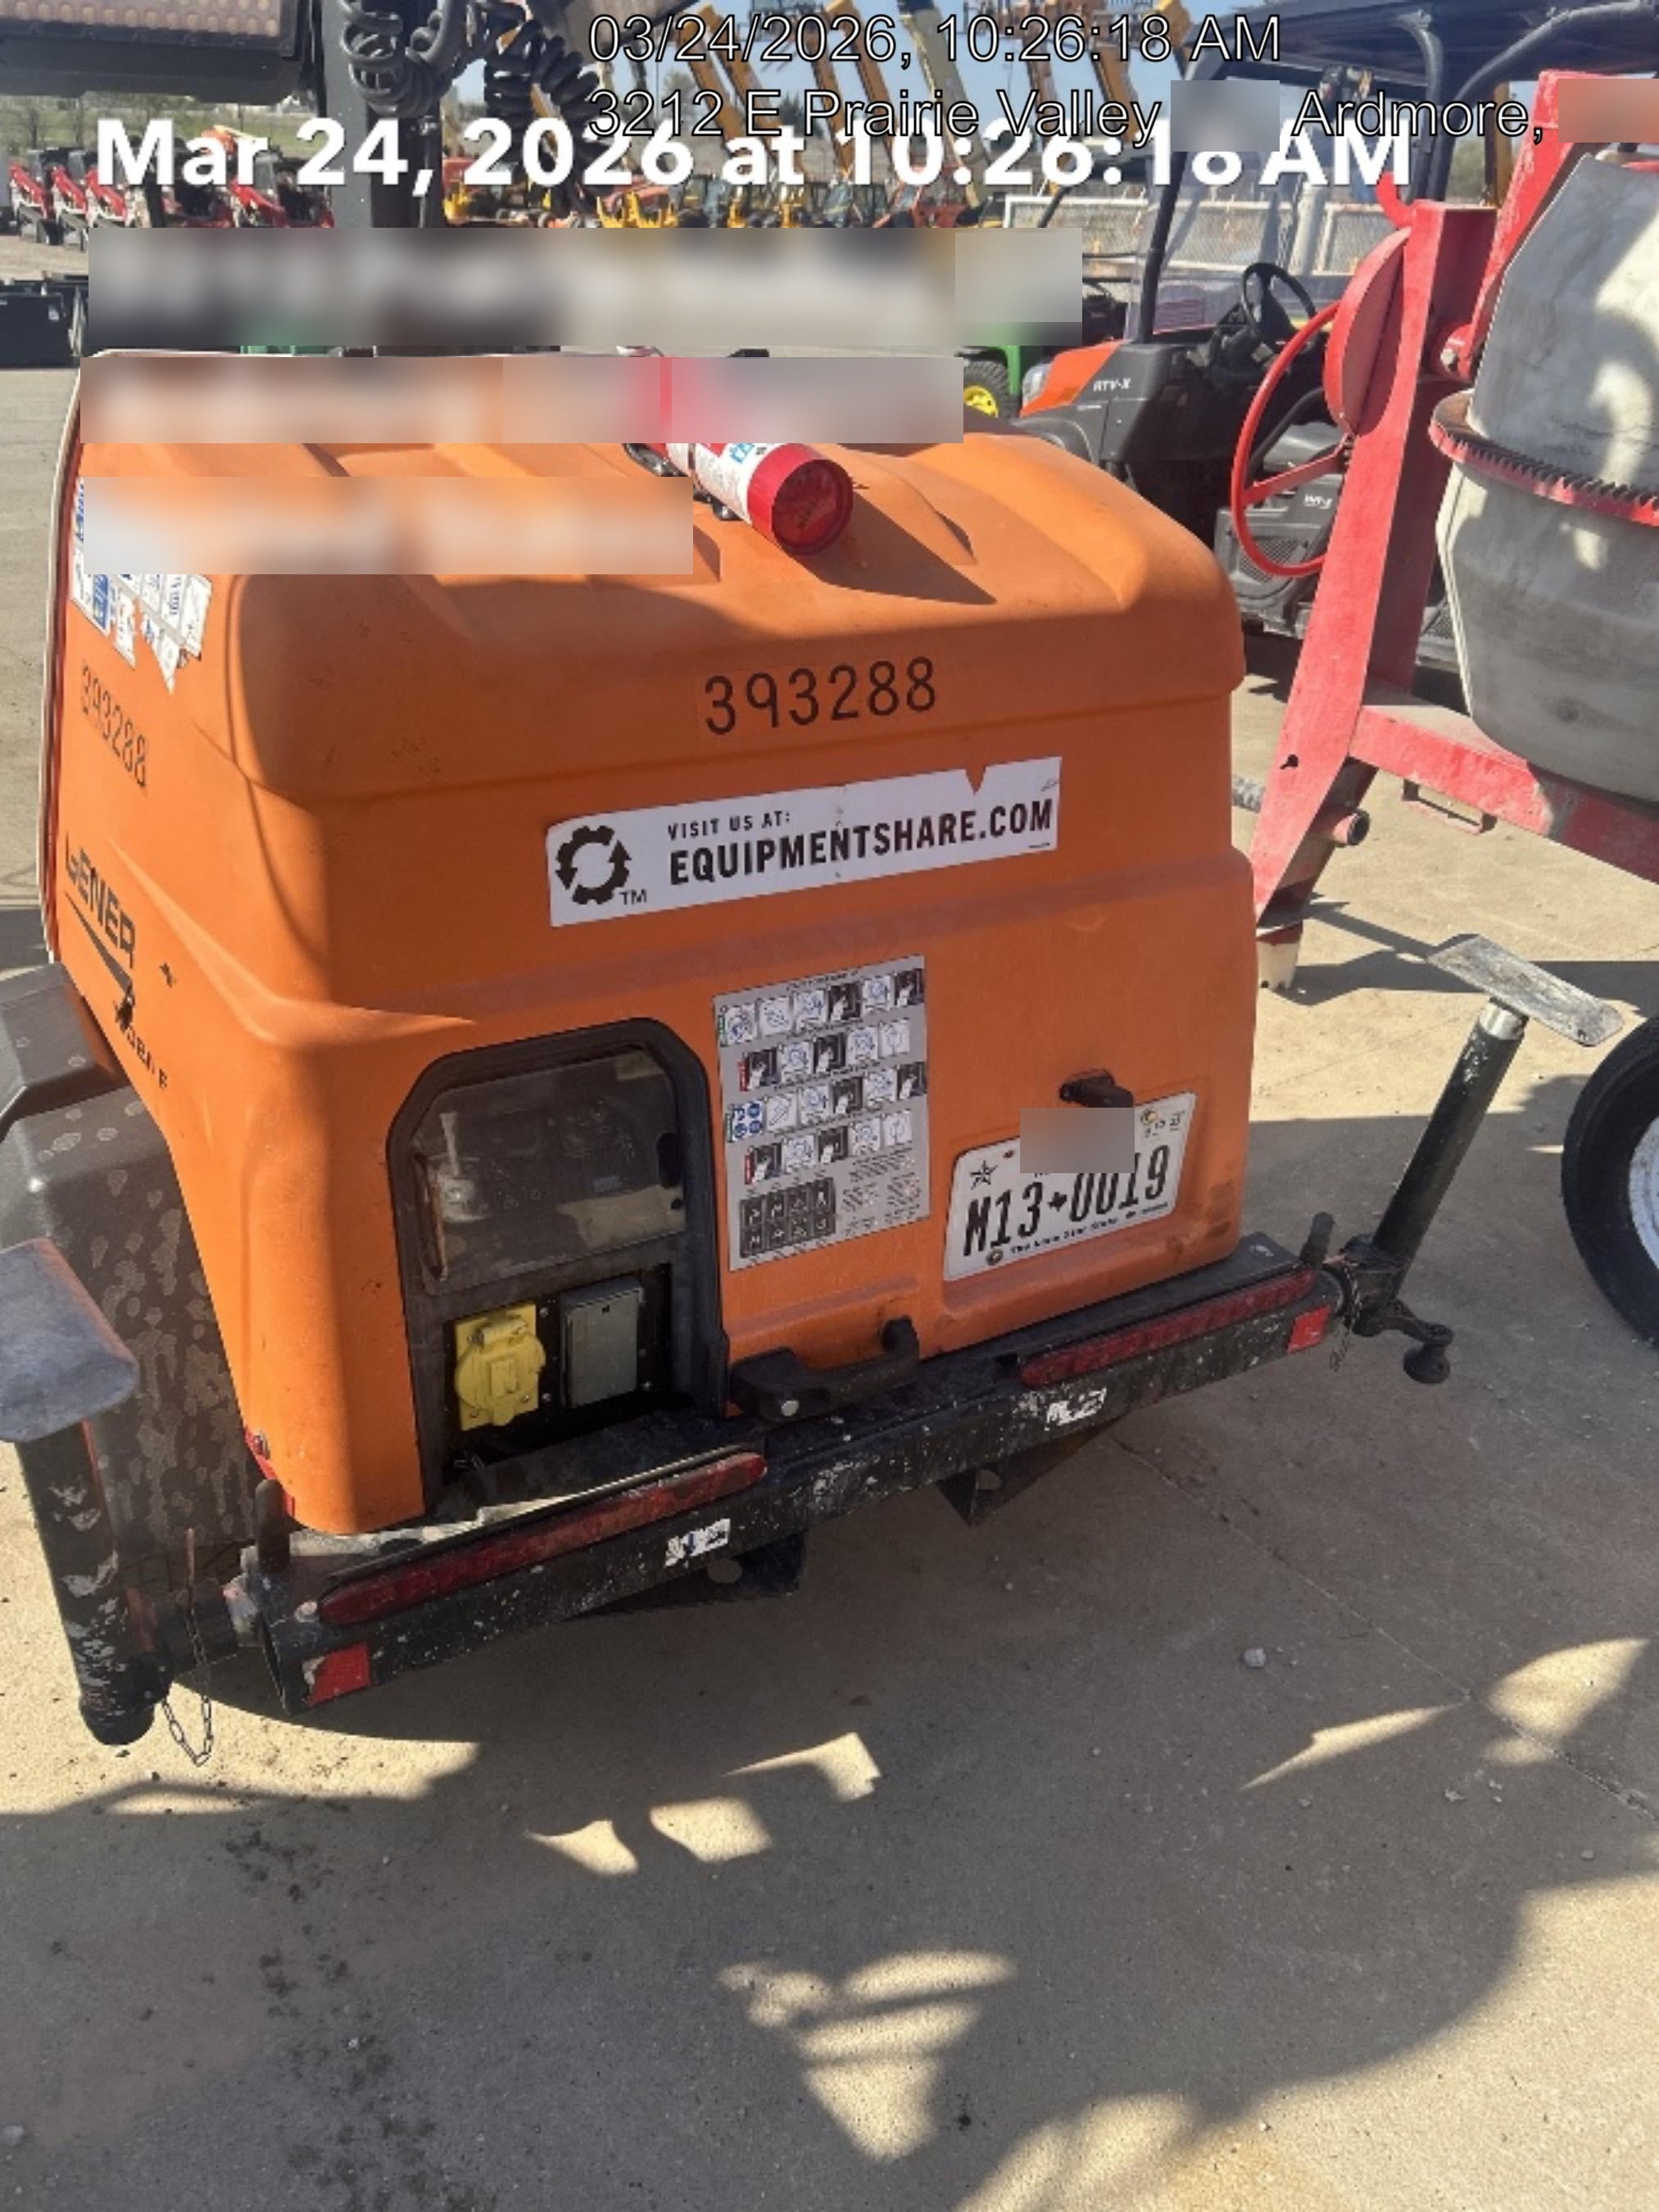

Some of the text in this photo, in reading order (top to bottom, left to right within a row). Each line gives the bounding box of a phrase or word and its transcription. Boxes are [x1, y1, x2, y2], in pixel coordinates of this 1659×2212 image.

[704, 656, 937, 736] 393288
[668, 810, 791, 841] VISIT US AT:
[669, 799, 1053, 886] EQUIPMENTSHARE.COM
[620, 889, 647, 905] TM
